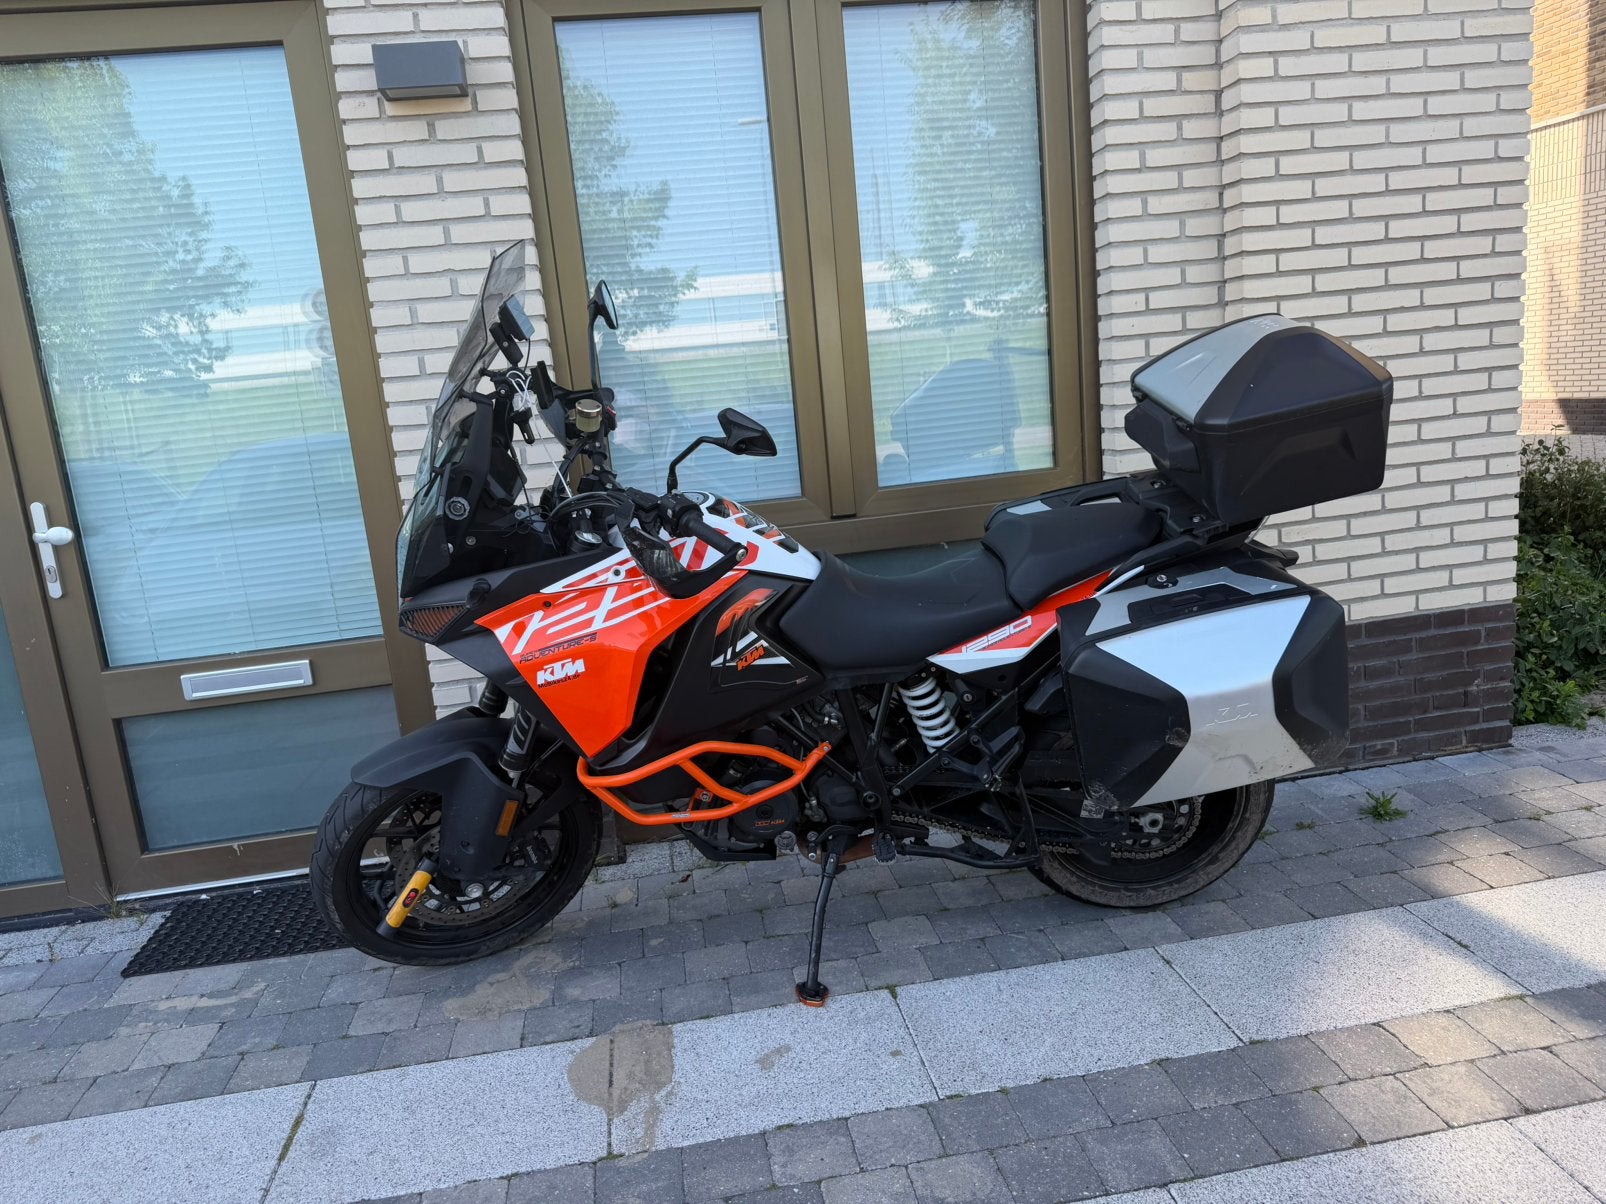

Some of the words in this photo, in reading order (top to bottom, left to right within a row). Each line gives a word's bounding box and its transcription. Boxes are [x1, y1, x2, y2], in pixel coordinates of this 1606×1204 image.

[961, 615, 1032, 654] 1290
[736, 644, 766, 671] KTM
[536, 658, 586, 685] KTM
